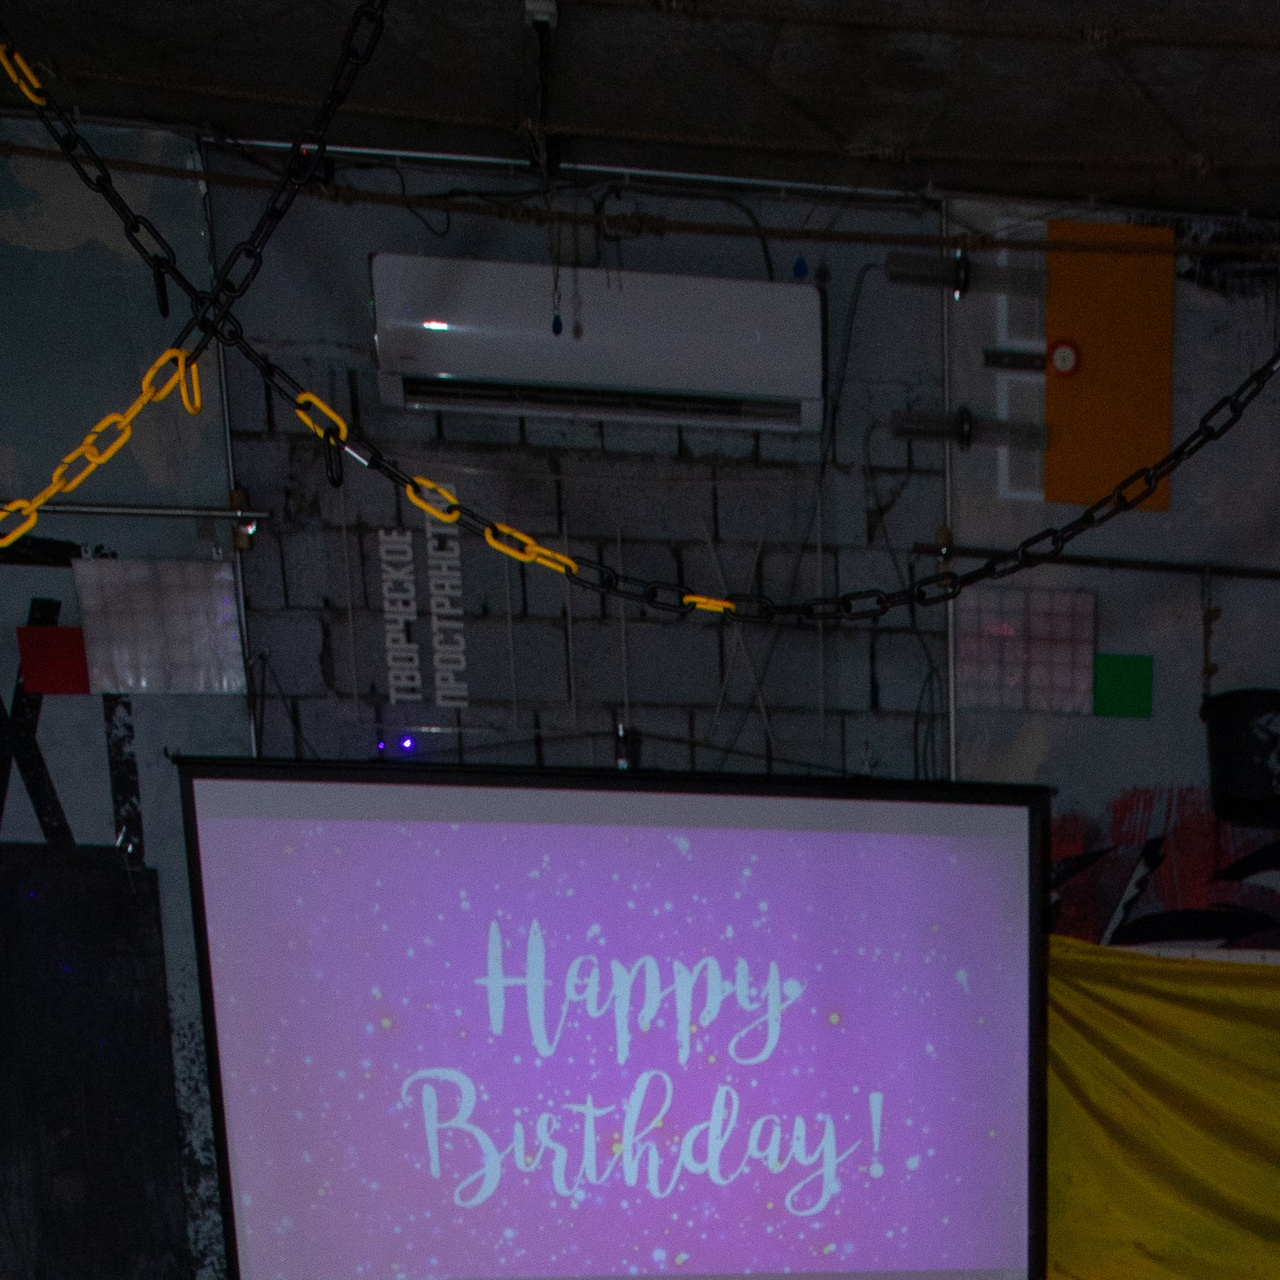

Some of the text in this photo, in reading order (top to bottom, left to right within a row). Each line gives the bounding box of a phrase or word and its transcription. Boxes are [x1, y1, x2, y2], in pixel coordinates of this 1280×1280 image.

[379, 529, 422, 706] ТВОРЧЕСКОЕ
[425, 482, 469, 708] ПРОСТРАНСТО
[474, 918, 801, 1065] Happy
[401, 1067, 884, 1216] Birthday!
